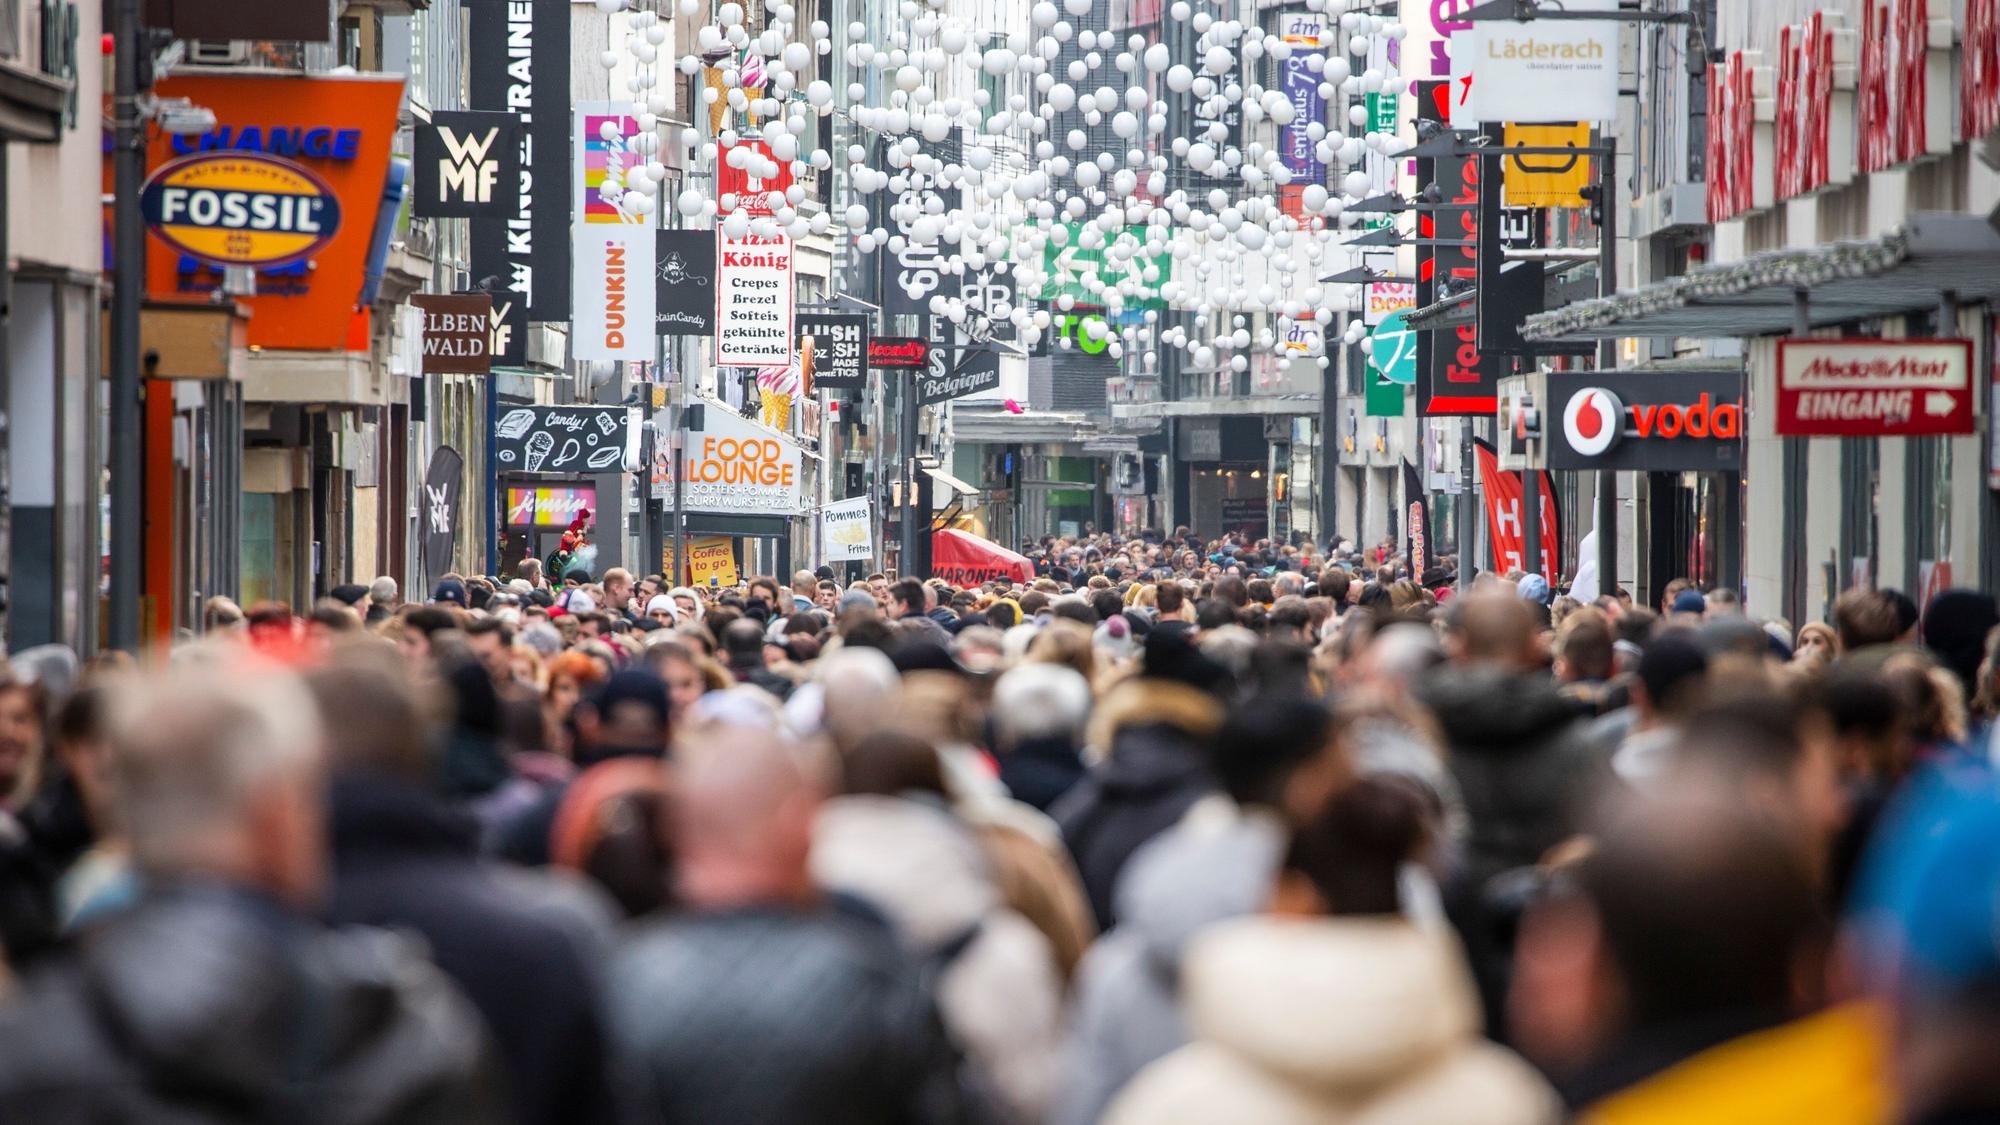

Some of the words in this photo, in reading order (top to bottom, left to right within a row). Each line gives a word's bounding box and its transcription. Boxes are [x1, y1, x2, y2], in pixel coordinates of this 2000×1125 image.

[1289, 18, 1320, 35] dm
[1488, 38, 1603, 59] Läderach
[723, 252, 788, 271] König
[732, 278, 778, 290] Crepes
[732, 293, 777, 305] Brezel
[676, 311, 706, 329] Candy
[730, 309, 778, 322] Softeis
[723, 325, 785, 340] gekühlte
[721, 342, 787, 355] Getränke
[923, 370, 994, 397] Belgique
[1796, 391, 1913, 420] EINGANG
[1632, 392, 1743, 439] voda
[704, 437, 780, 462] FOOD
[689, 458, 793, 486] LOUNGE
[693, 485, 736, 496] SOFTEIS
[743, 486, 789, 497] POMMES
[767, 499, 796, 510] PIZZA
[825, 508, 867, 523] Pommes
[692, 546, 729, 559] Coffee
[848, 543, 870, 554] Frites
[695, 561, 707, 570] to
[712, 559, 728, 571] go
